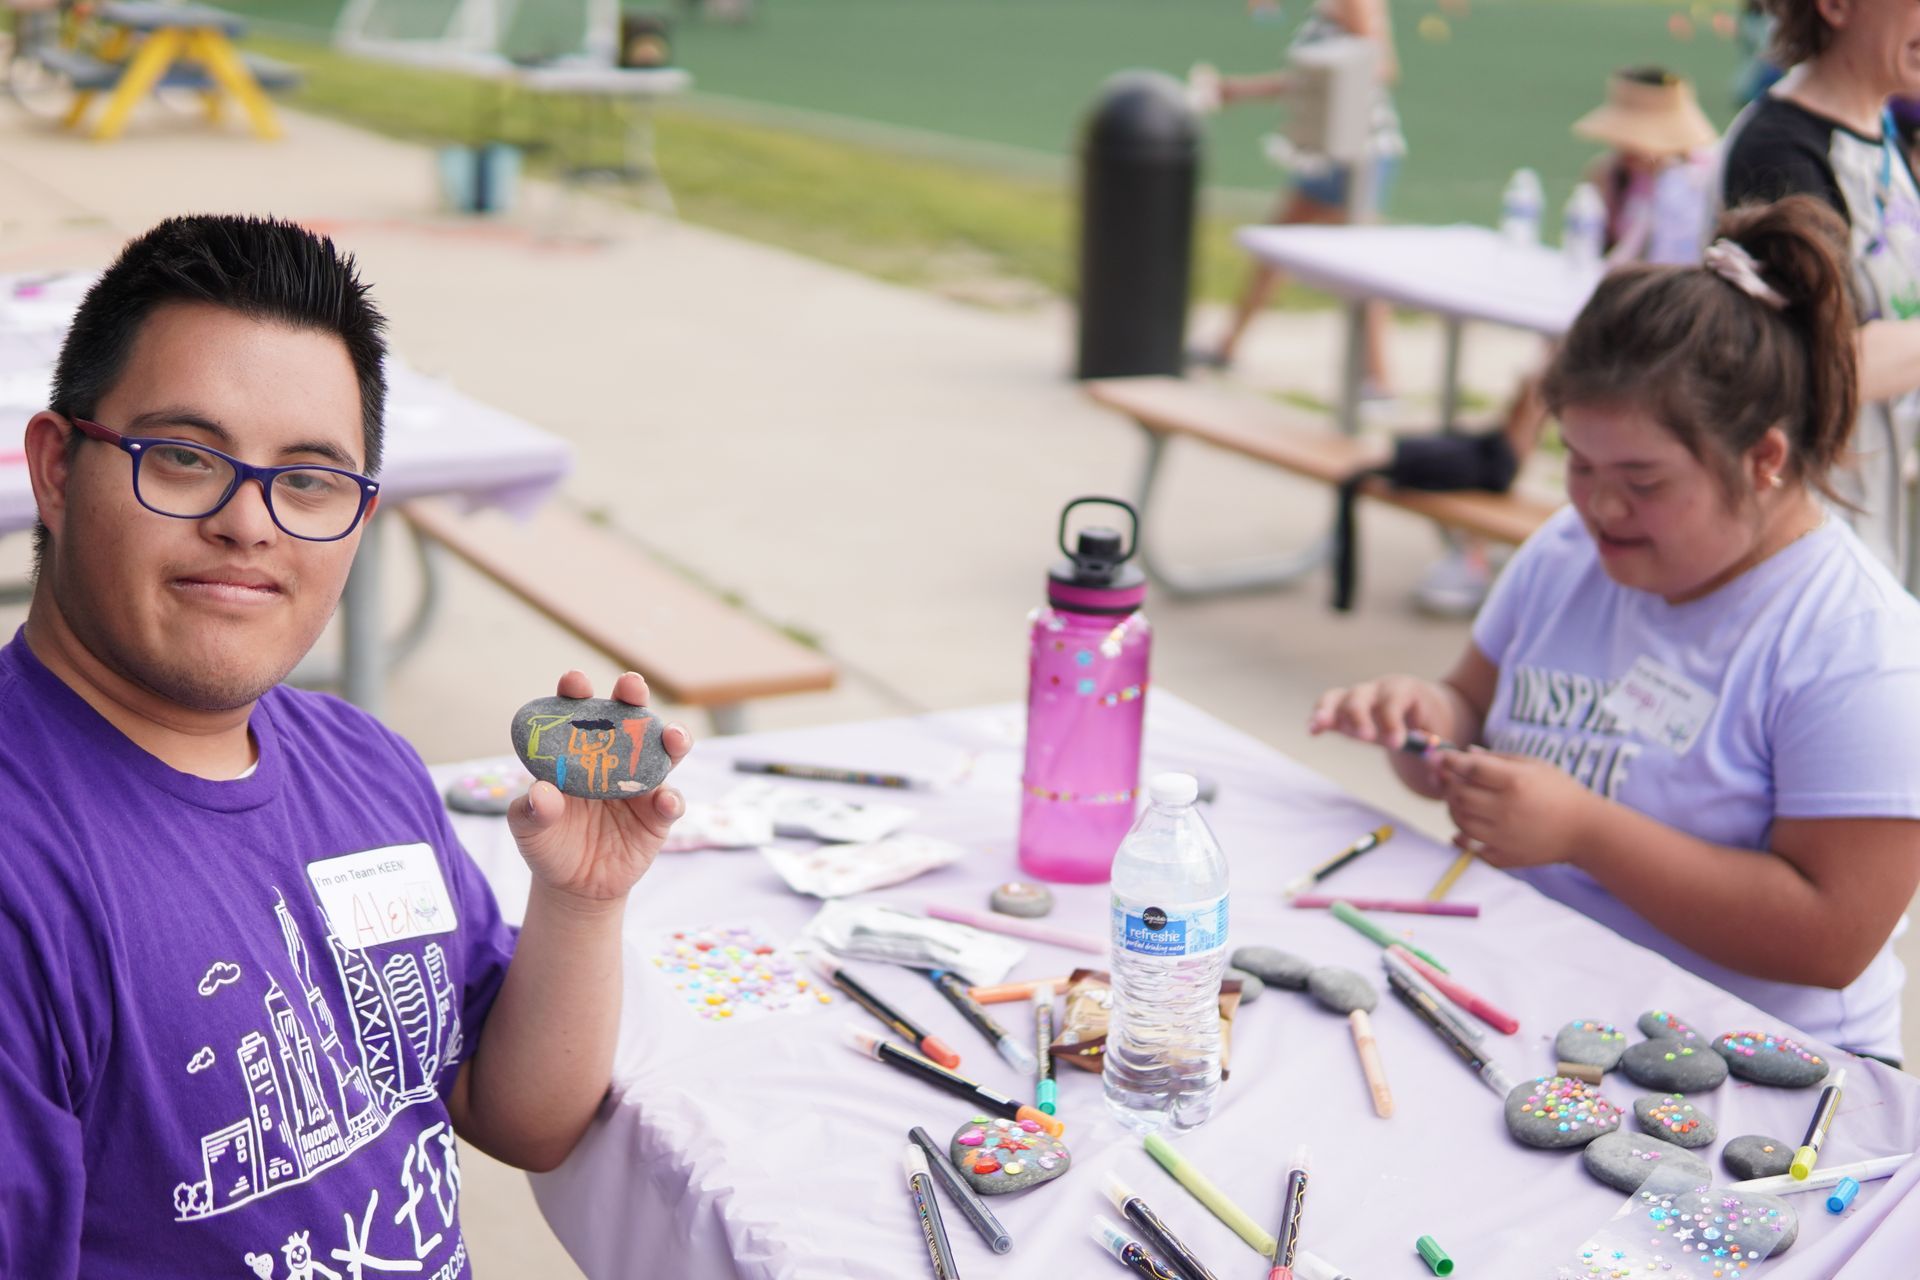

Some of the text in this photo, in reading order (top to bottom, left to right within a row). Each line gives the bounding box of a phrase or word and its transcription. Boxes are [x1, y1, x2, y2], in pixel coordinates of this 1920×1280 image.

[315, 876, 333, 888] I'm
[334, 873, 348, 884] on
[348, 867, 377, 881] Team
[1169, 944, 1185, 952] water
